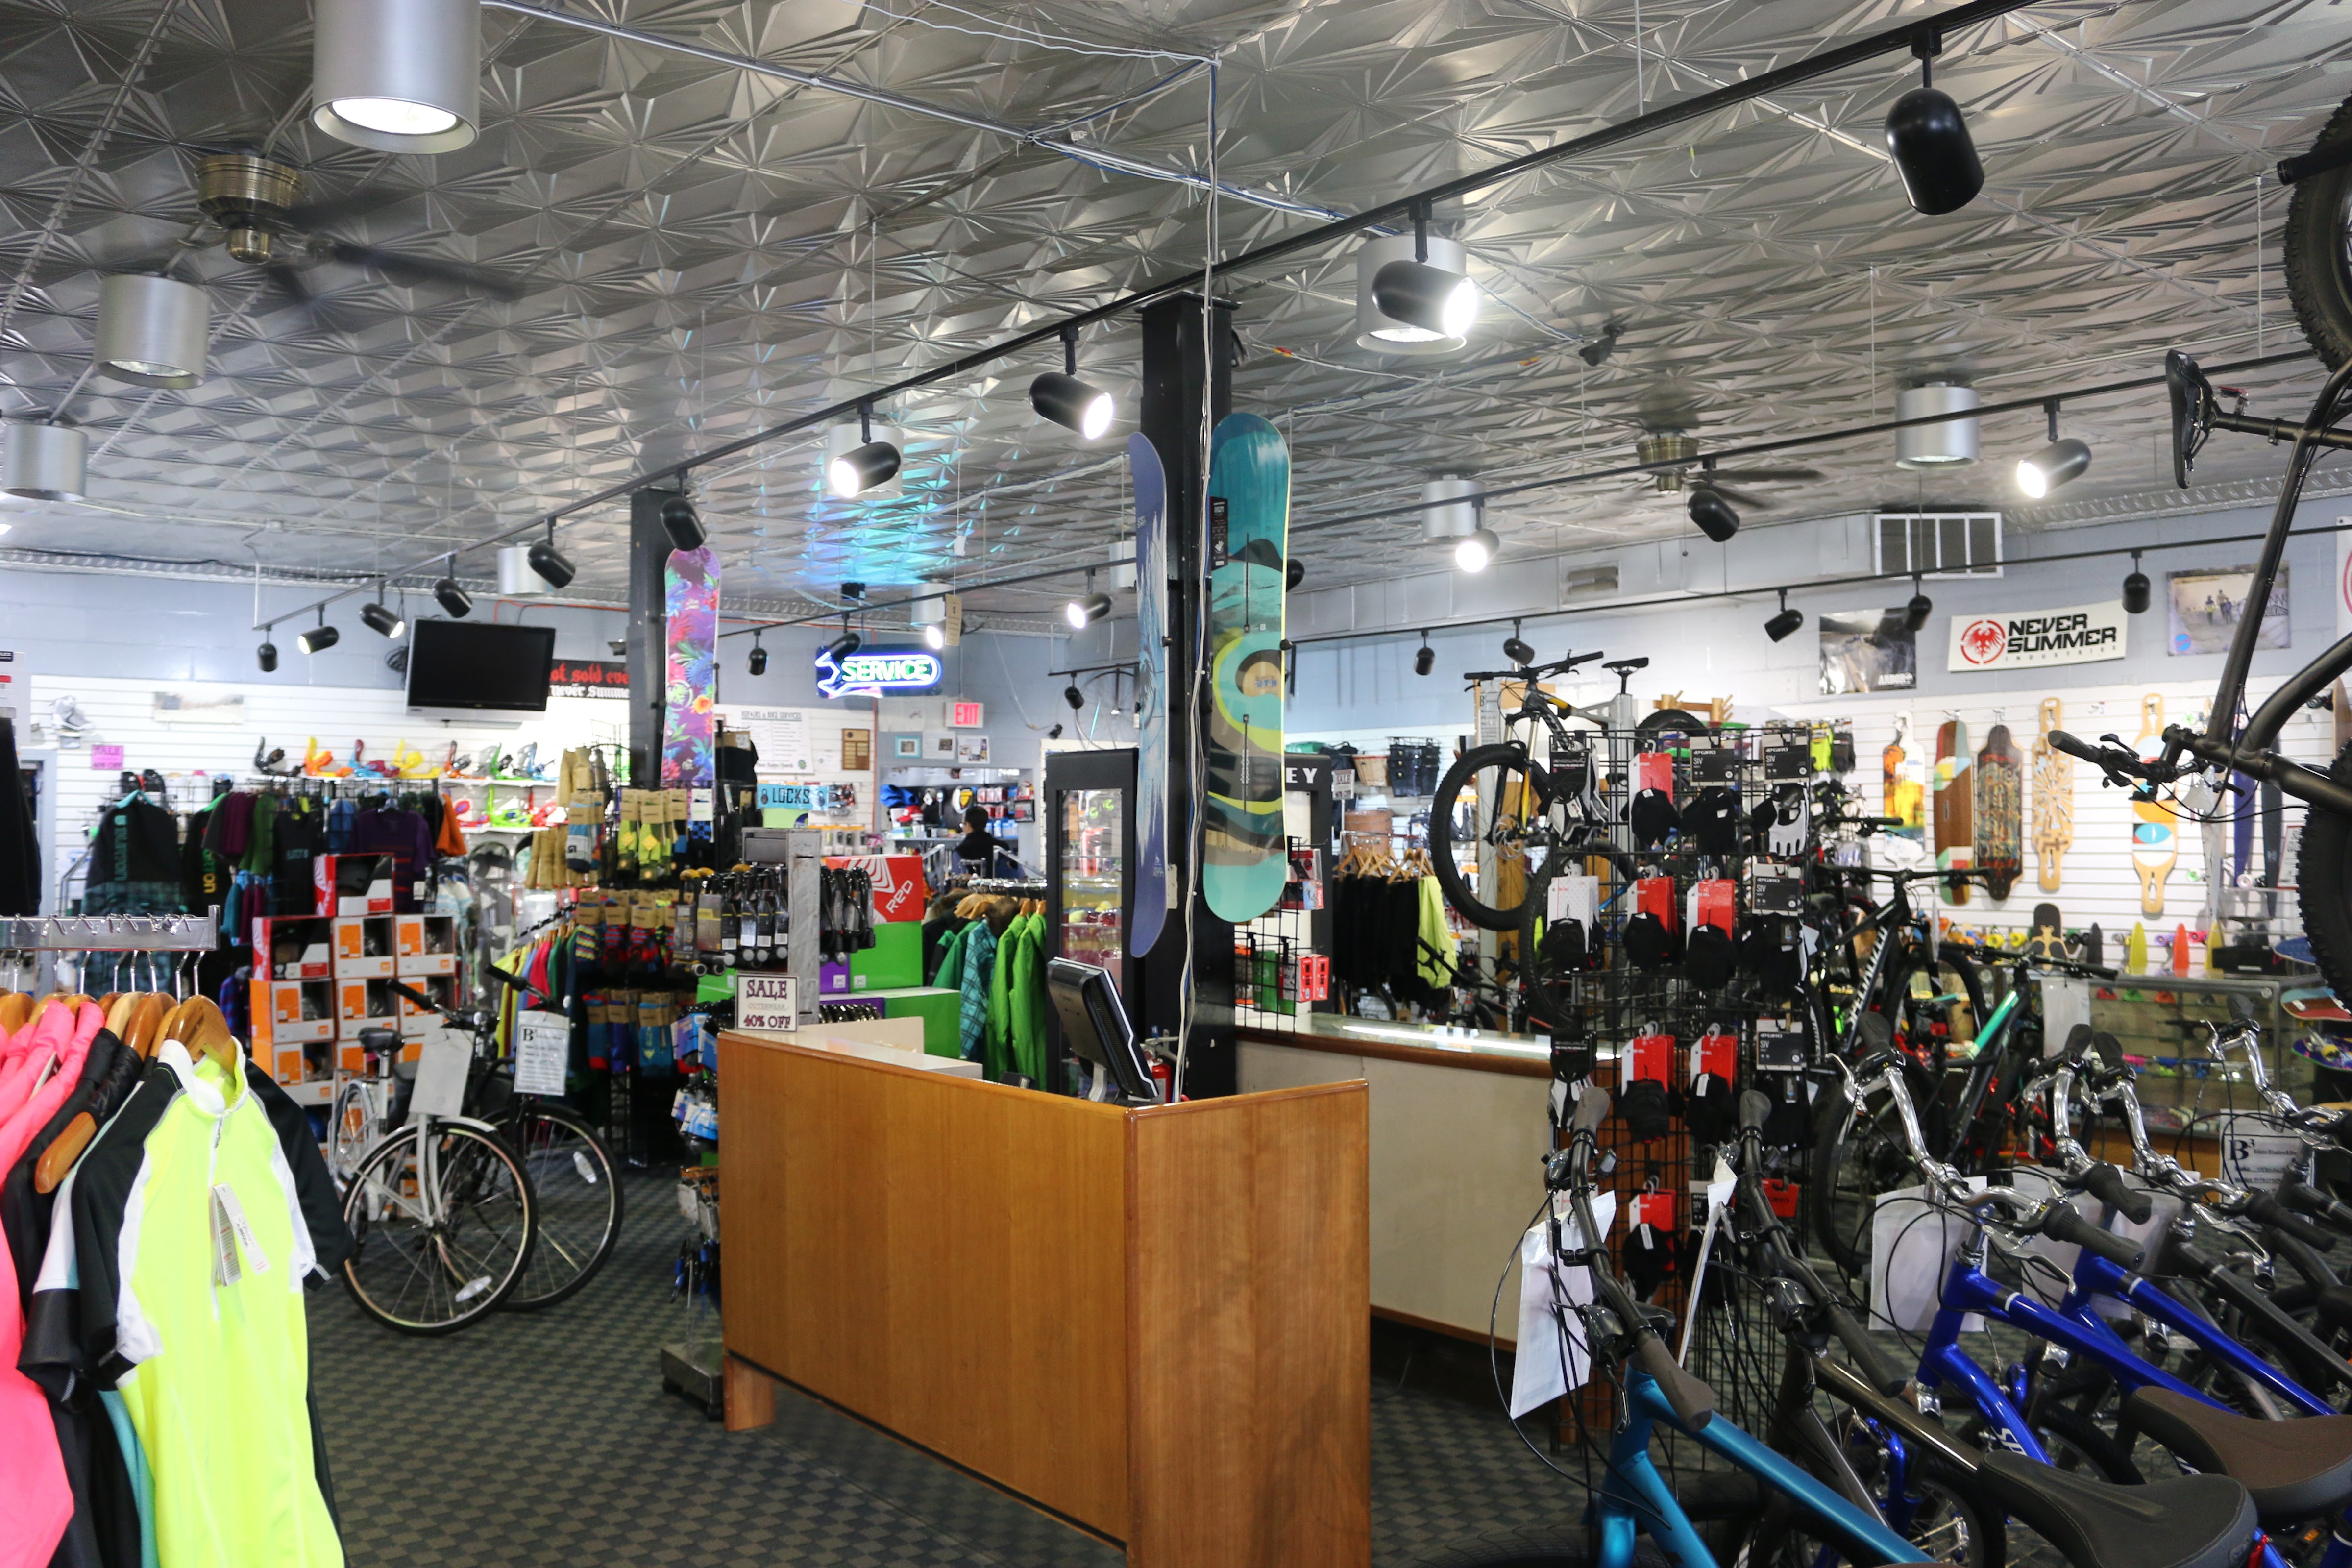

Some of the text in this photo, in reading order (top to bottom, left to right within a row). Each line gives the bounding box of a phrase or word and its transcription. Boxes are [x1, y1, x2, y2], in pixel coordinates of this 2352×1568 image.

[2009, 613, 2087, 637] NEVER
[2007, 627, 2116, 653] SUMMER
[550, 662, 630, 685] ot sold eve
[841, 660, 931, 682] SERVICE
[587, 685, 630, 699] Summe
[955, 703, 980, 725] EXIT
[1286, 767, 1318, 784] EY
[772, 787, 810, 804] LOCKS
[885, 879, 914, 914] RED
[746, 980, 787, 1000] SALE
[744, 1014, 790, 1028] 40% OFF
